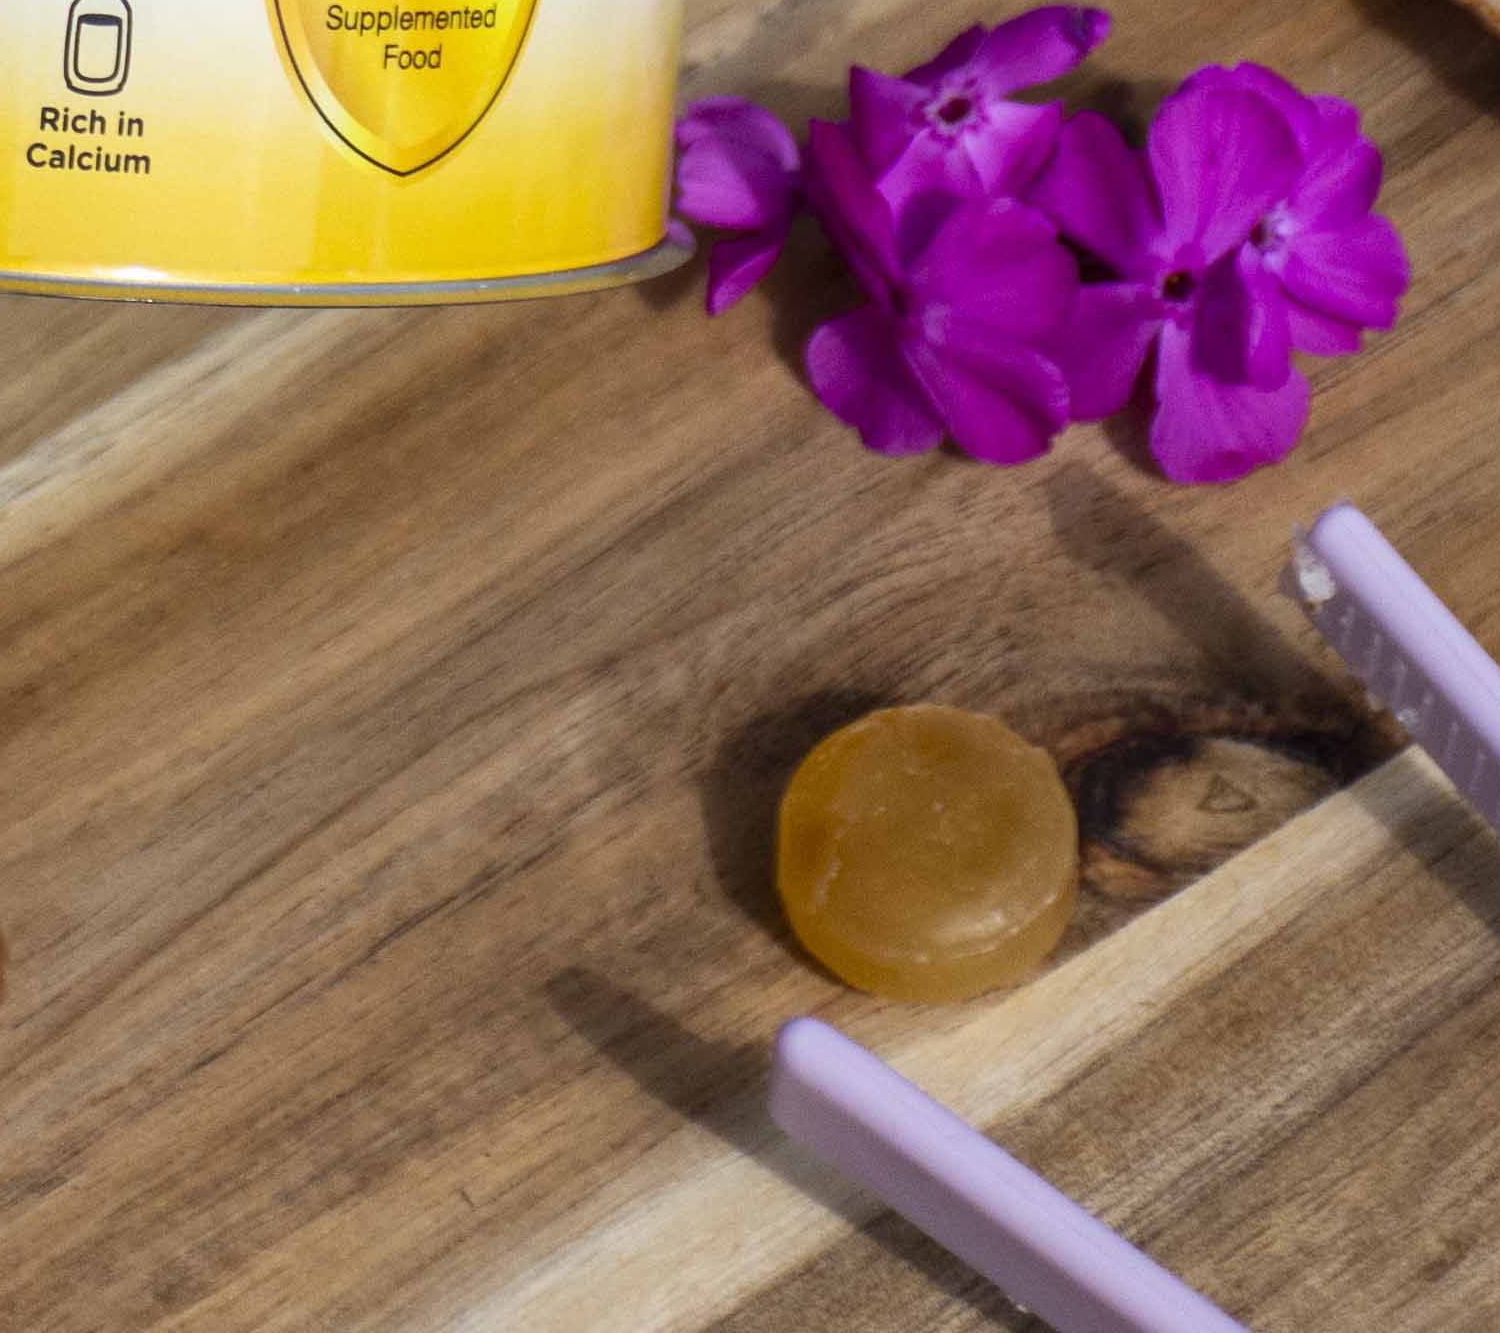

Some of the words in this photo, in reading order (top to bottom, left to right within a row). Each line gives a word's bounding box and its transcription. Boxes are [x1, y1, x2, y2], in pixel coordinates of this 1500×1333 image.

[326, 2, 498, 36] Supplemented
[383, 44, 443, 71] Food
[39, 106, 107, 135] Rich
[118, 111, 145, 137] in
[26, 142, 152, 175] Calcium
